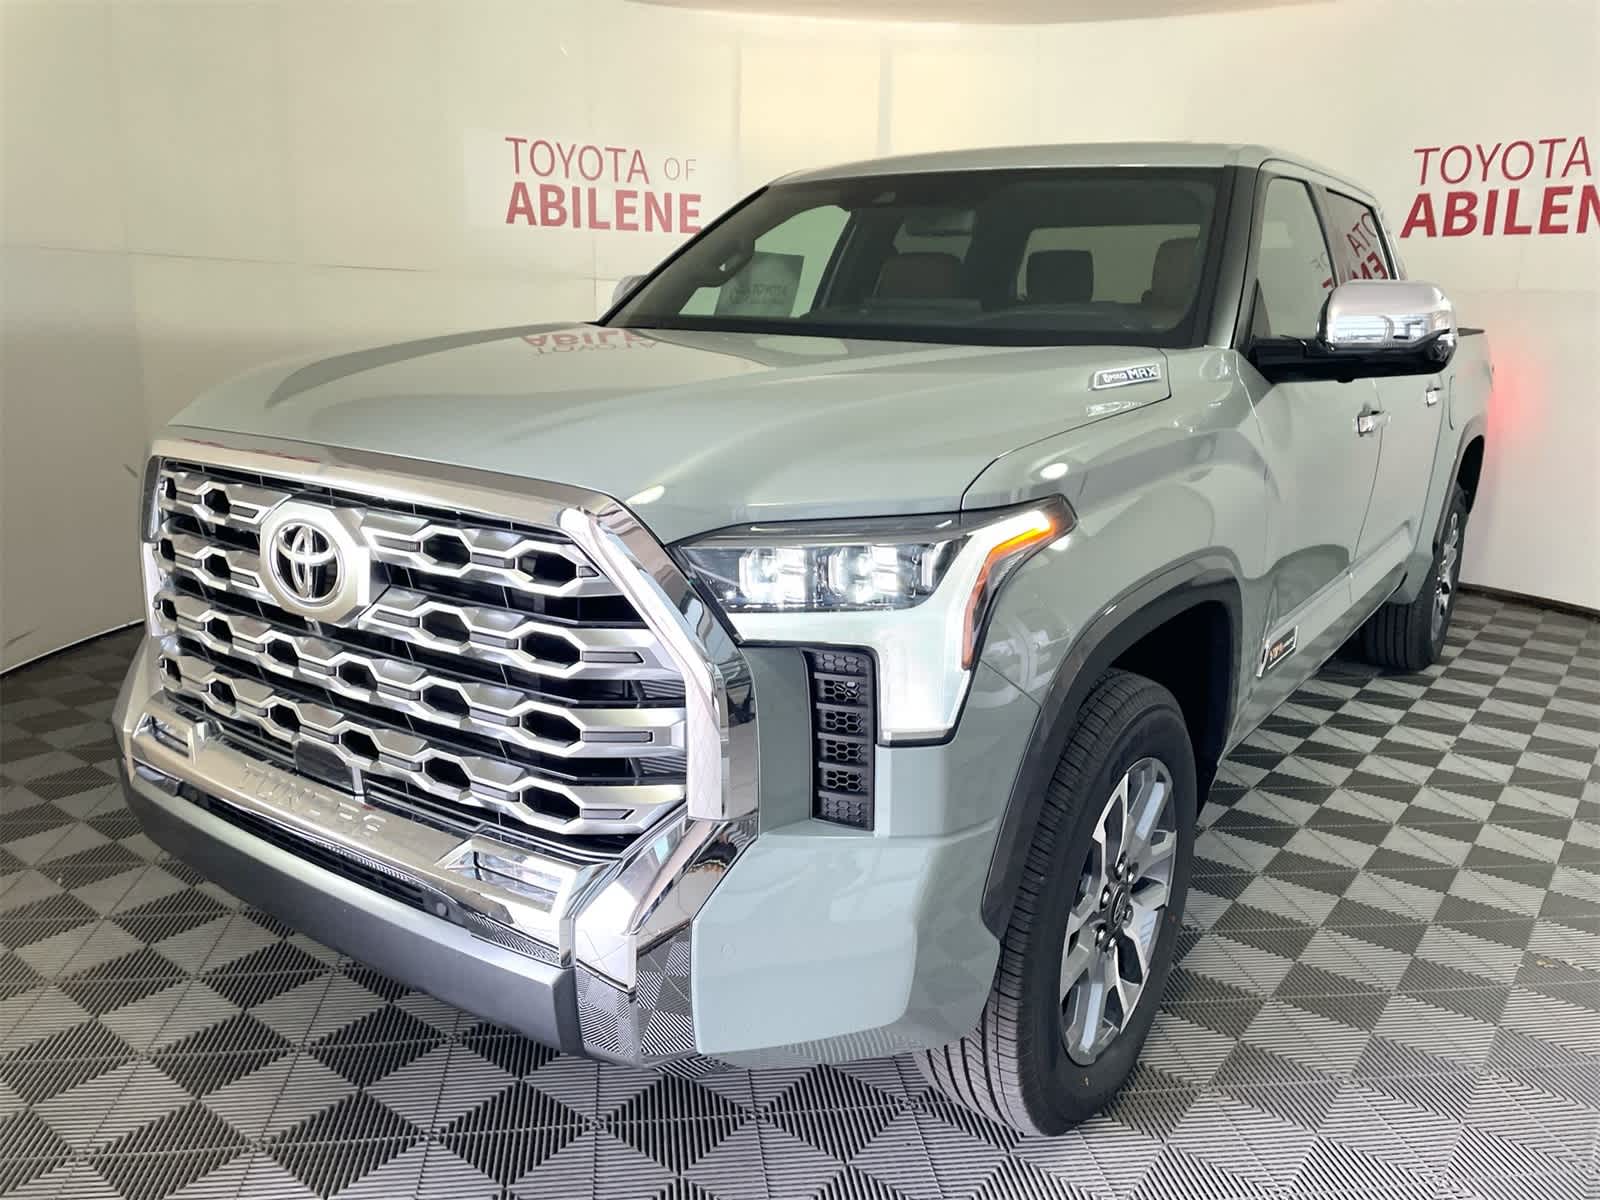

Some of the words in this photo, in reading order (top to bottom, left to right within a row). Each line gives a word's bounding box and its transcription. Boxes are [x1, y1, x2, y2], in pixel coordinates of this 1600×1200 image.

[505, 137, 650, 184] TOYOTA
[664, 157, 697, 181] OF
[1414, 136, 1592, 185] TOYOTA
[505, 181, 701, 234] ABILENE
[1126, 366, 1157, 380] MAX
